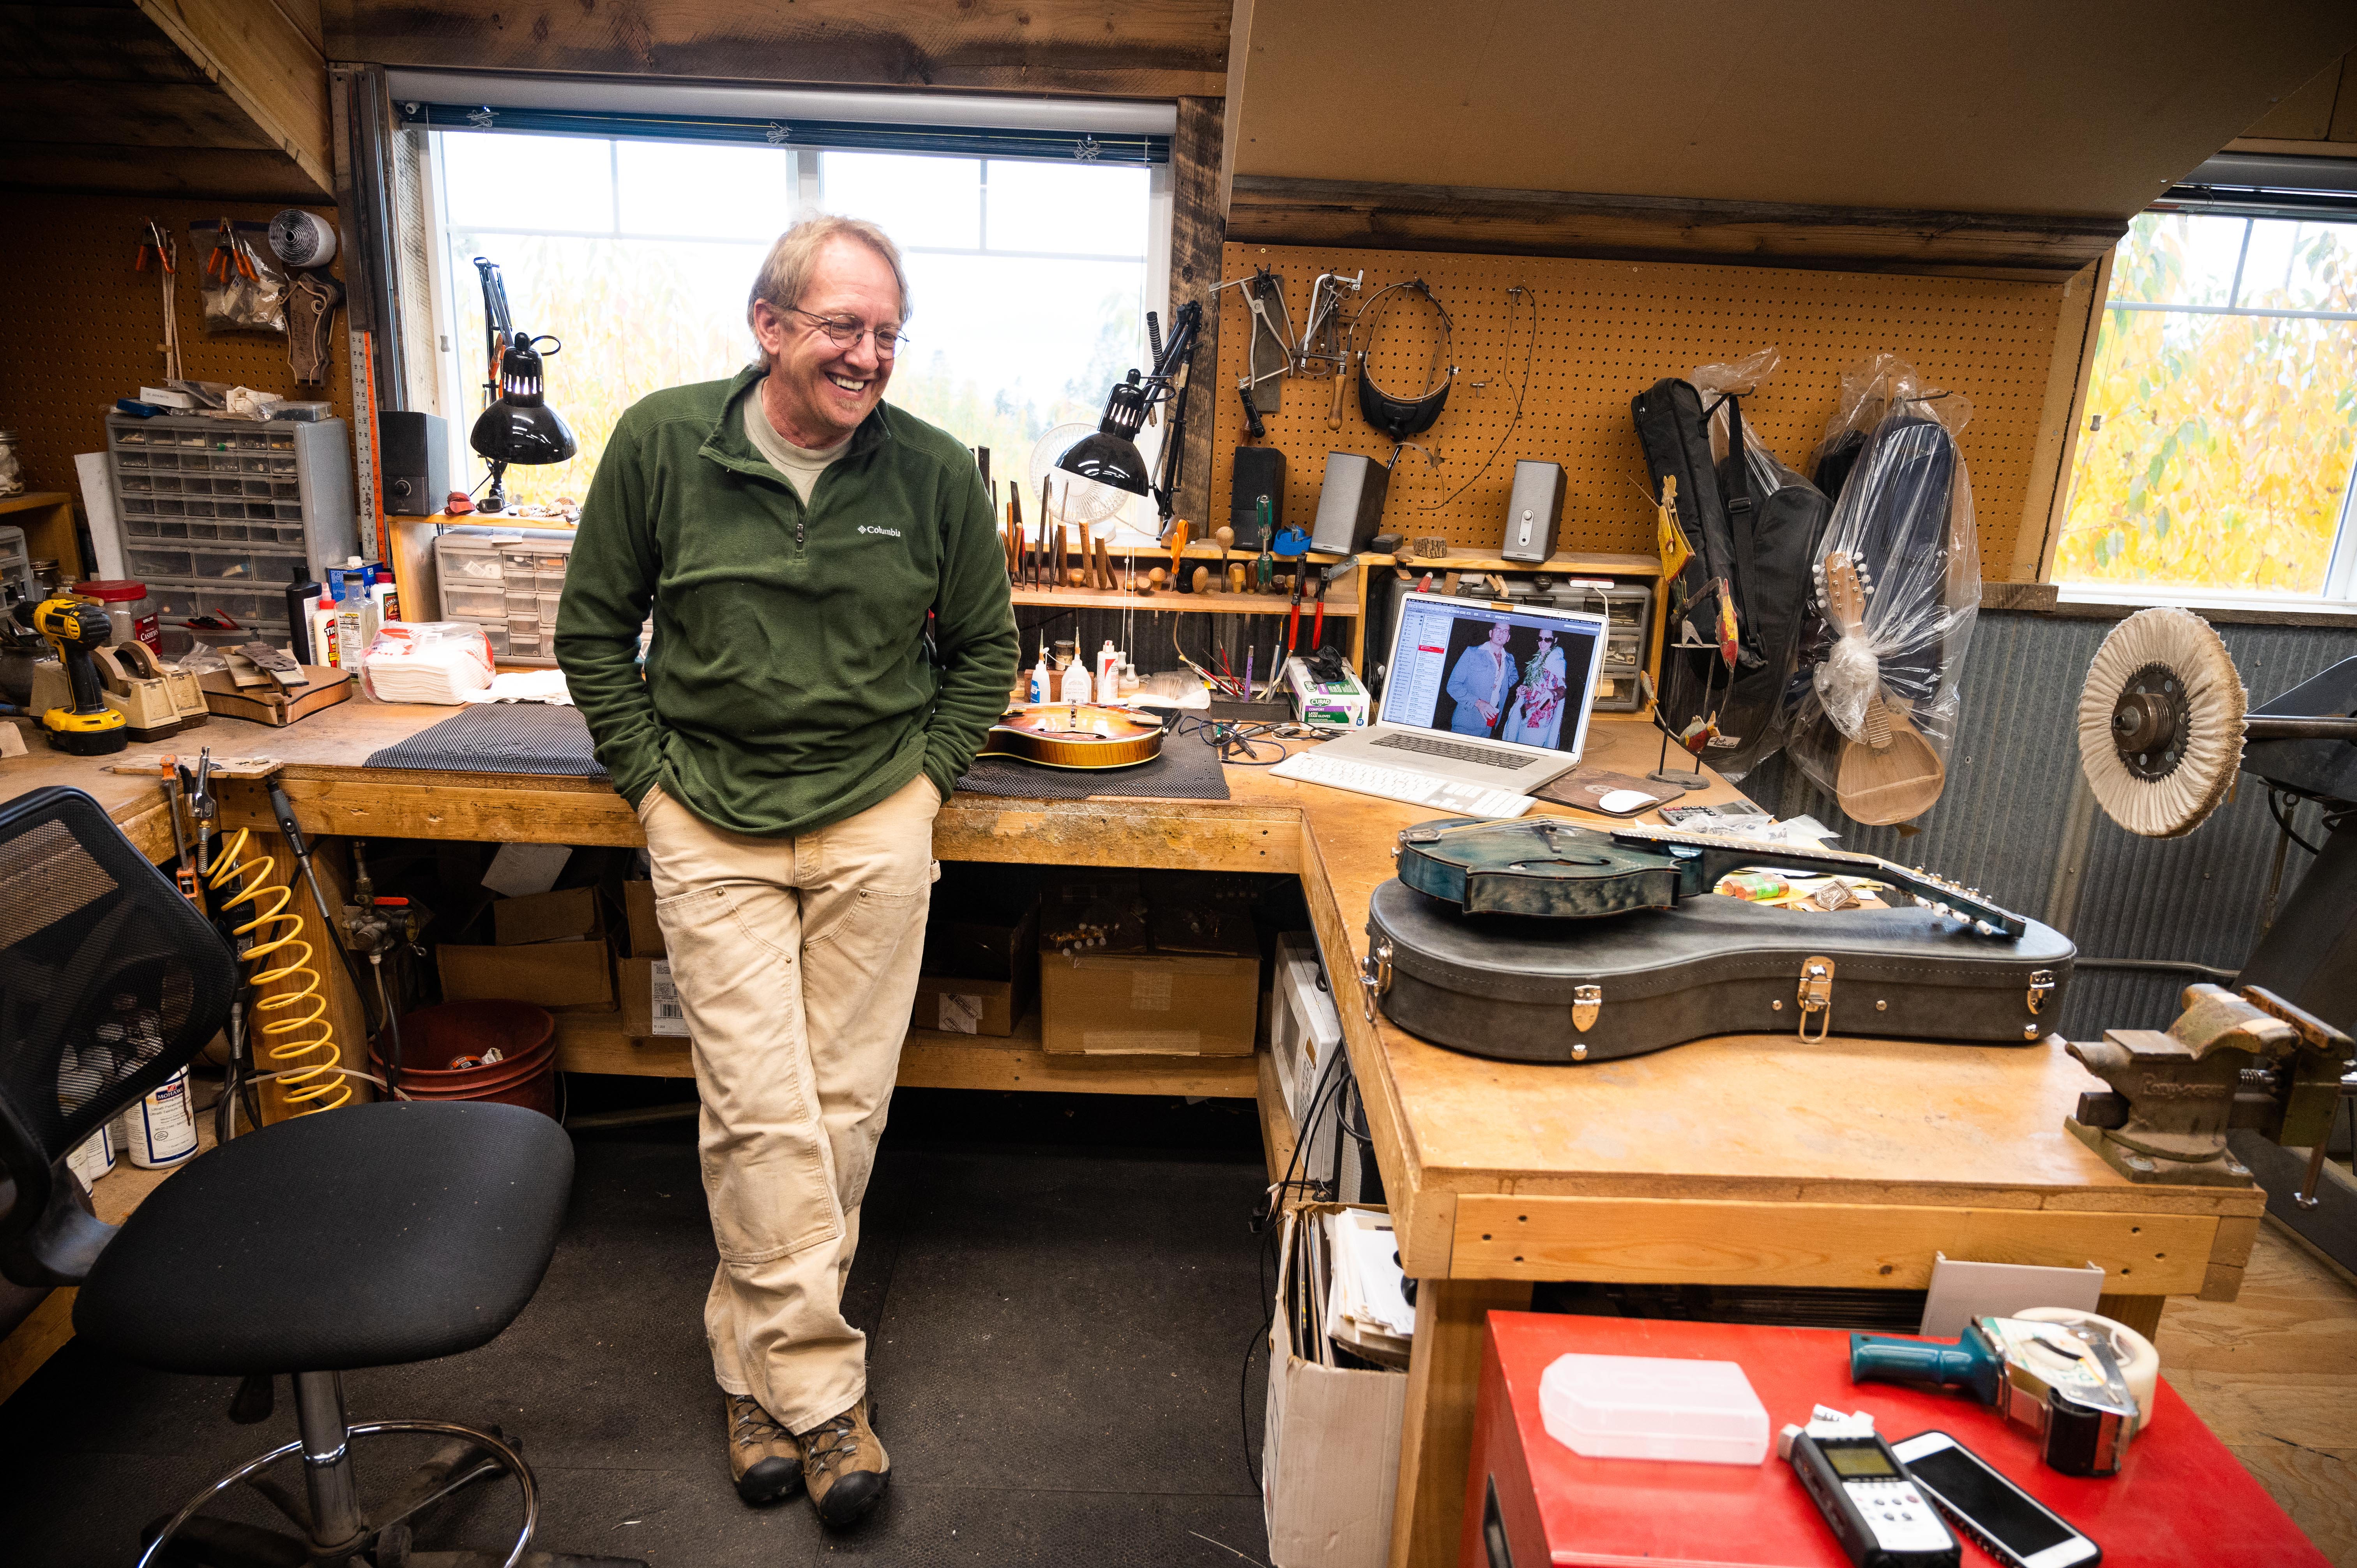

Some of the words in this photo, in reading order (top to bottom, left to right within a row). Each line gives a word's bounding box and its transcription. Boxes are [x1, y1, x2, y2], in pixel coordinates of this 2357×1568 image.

[867, 526, 901, 537] Columbia
[141, 629, 158, 641] CASHEWS
[954, 999, 974, 1017] MacDonald
